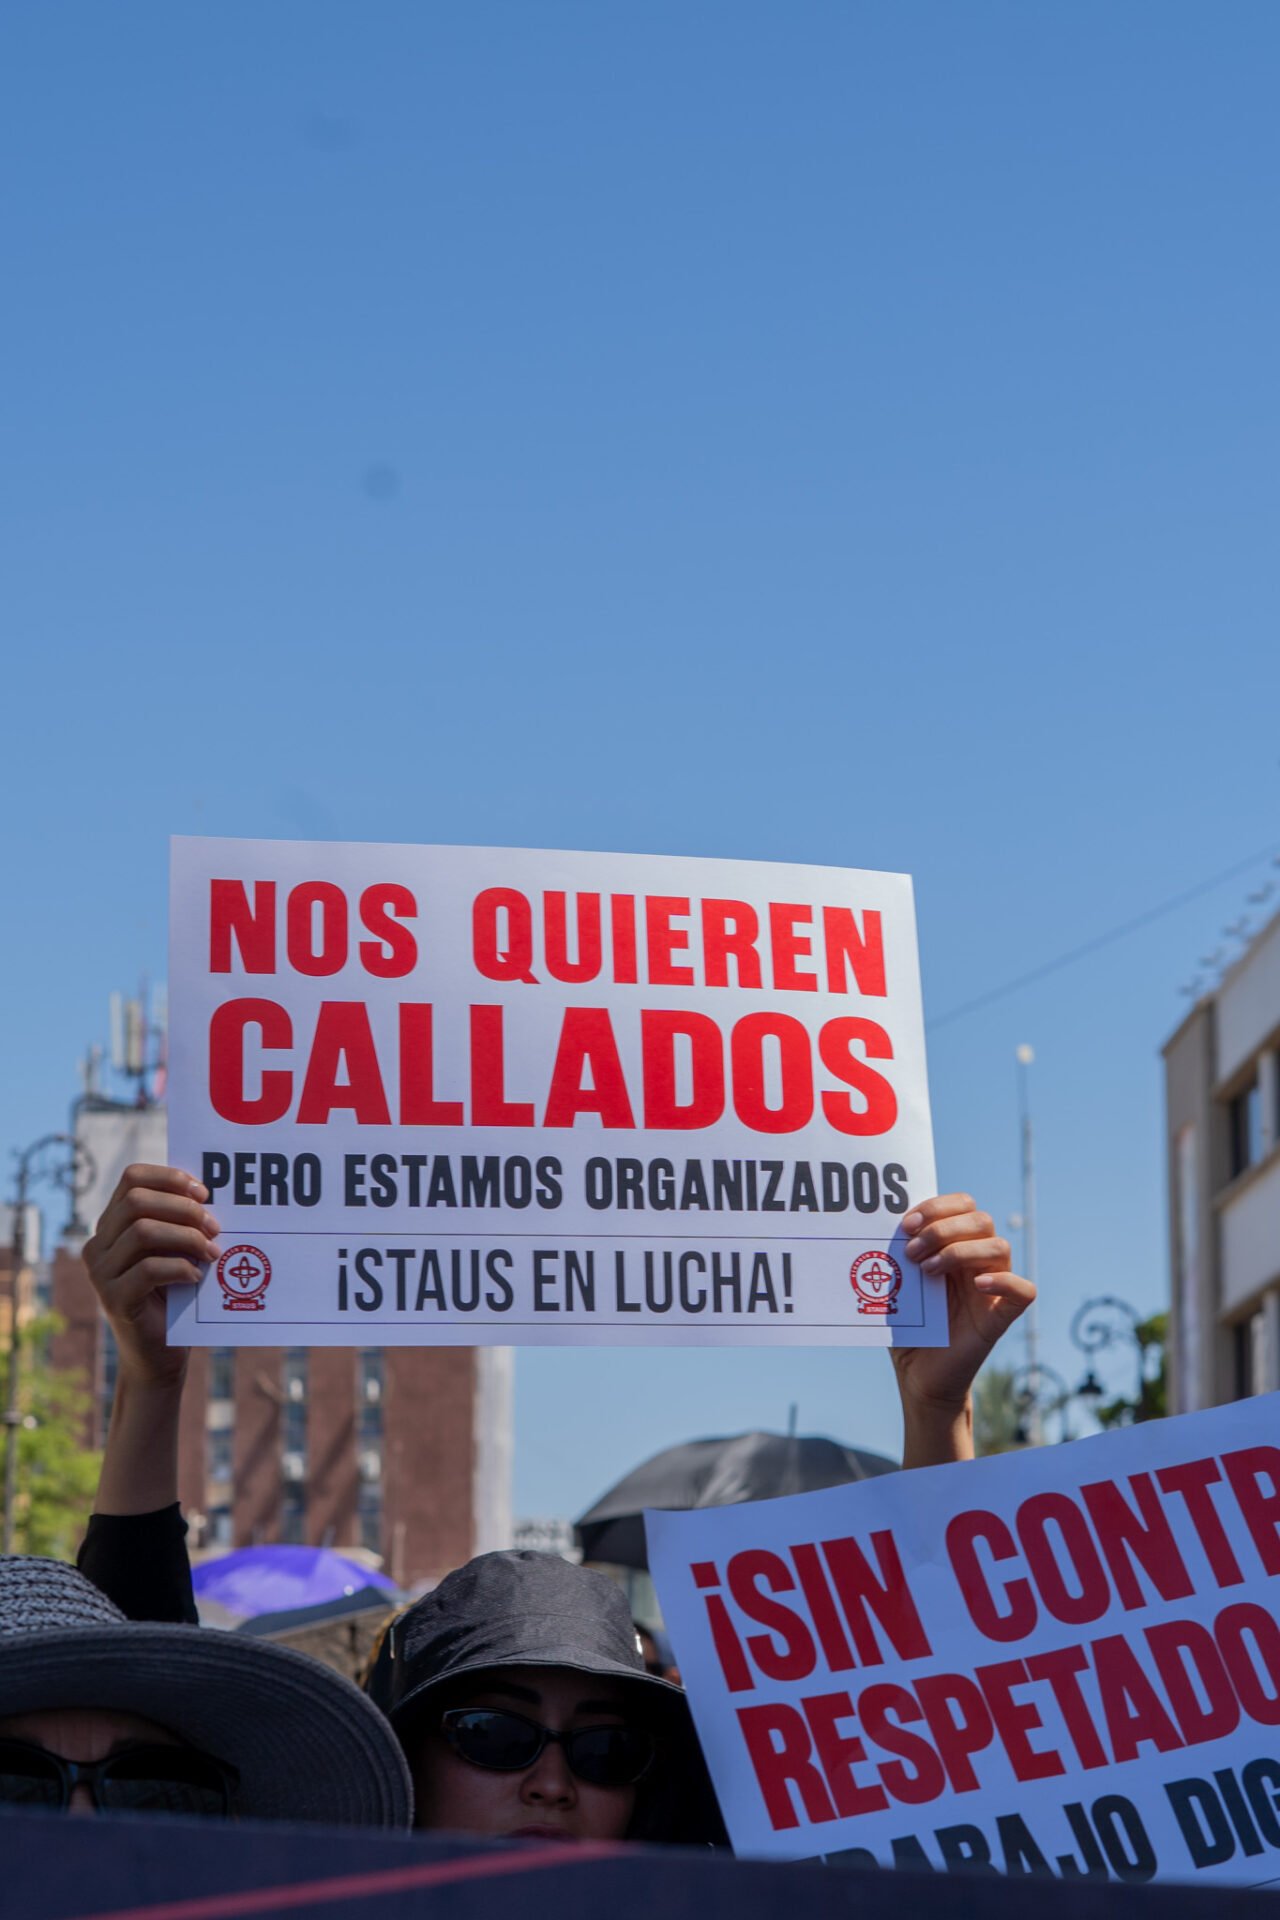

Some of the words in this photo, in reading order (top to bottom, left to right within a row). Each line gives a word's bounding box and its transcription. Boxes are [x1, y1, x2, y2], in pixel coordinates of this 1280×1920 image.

[210, 879, 418, 979] NOS
[472, 886, 888, 998] QUIEREN
[209, 997, 898, 1137] CALLADOS
[202, 1151, 322, 1207] PERO
[344, 1153, 563, 1211] ESTAMOS
[585, 1156, 909, 1214] ORGANIZADOS
[338, 1247, 514, 1313] ¡STAUS
[533, 1250, 595, 1313] EN
[615, 1250, 793, 1314] LUCHA!
[690, 1529, 933, 1692] ¡SIN
[735, 1602, 1280, 1831] RESPETADO
